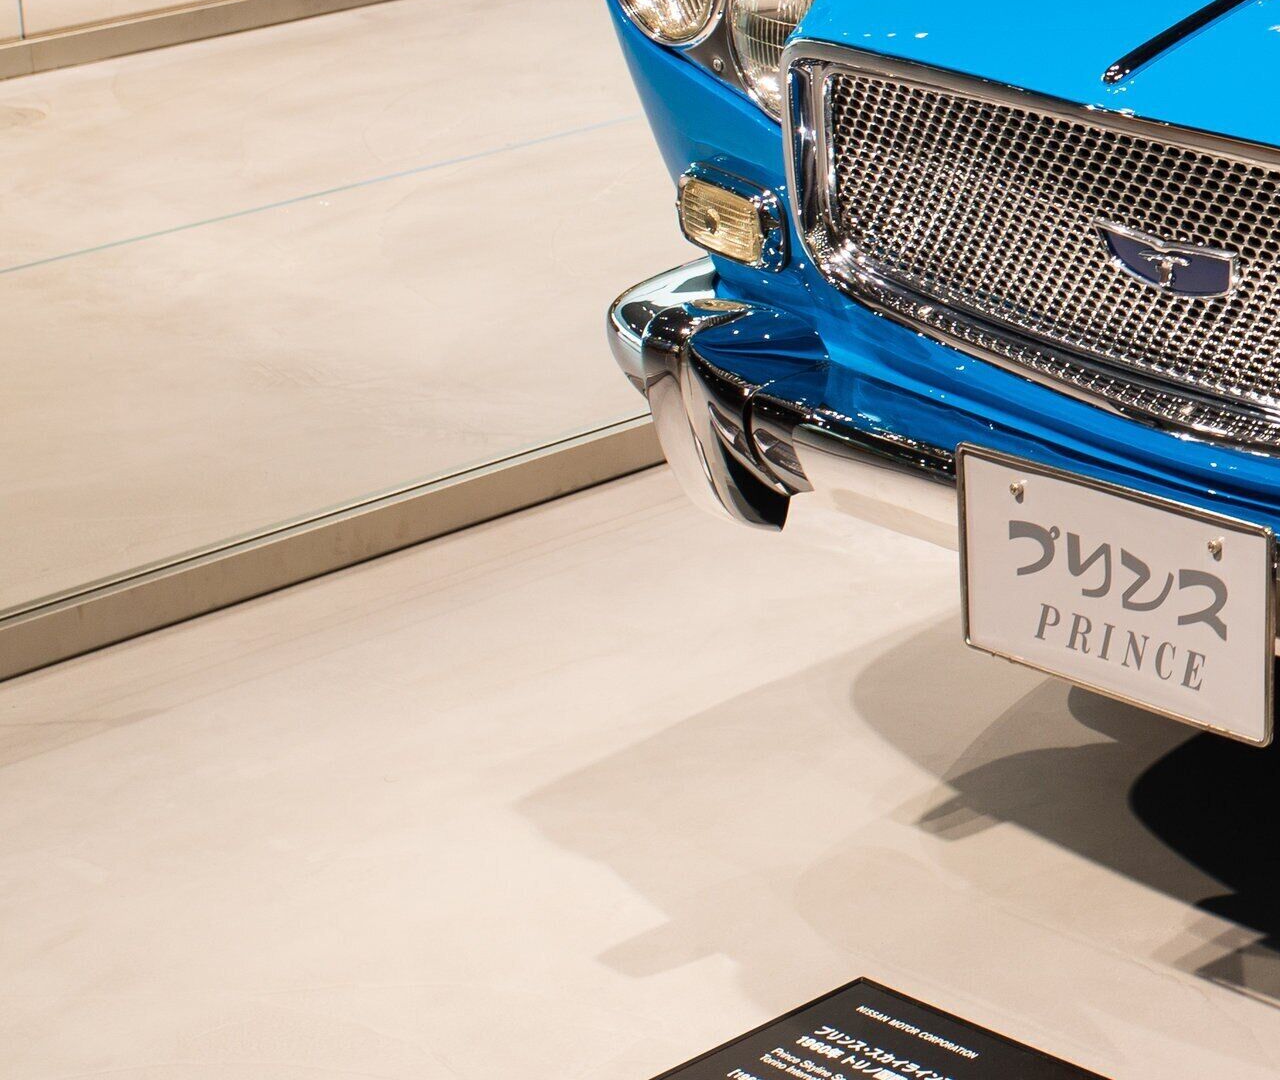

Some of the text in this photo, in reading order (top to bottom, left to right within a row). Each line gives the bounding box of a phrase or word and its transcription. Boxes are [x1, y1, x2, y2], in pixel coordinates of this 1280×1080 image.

[1009, 520, 1228, 642] プリンス
[1034, 603, 1206, 691] PRINCE
[814, 1025, 953, 1080] プリンス・スカイライン
[856, 1005, 979, 1059] NISSAN MOTOR CORPORATION
